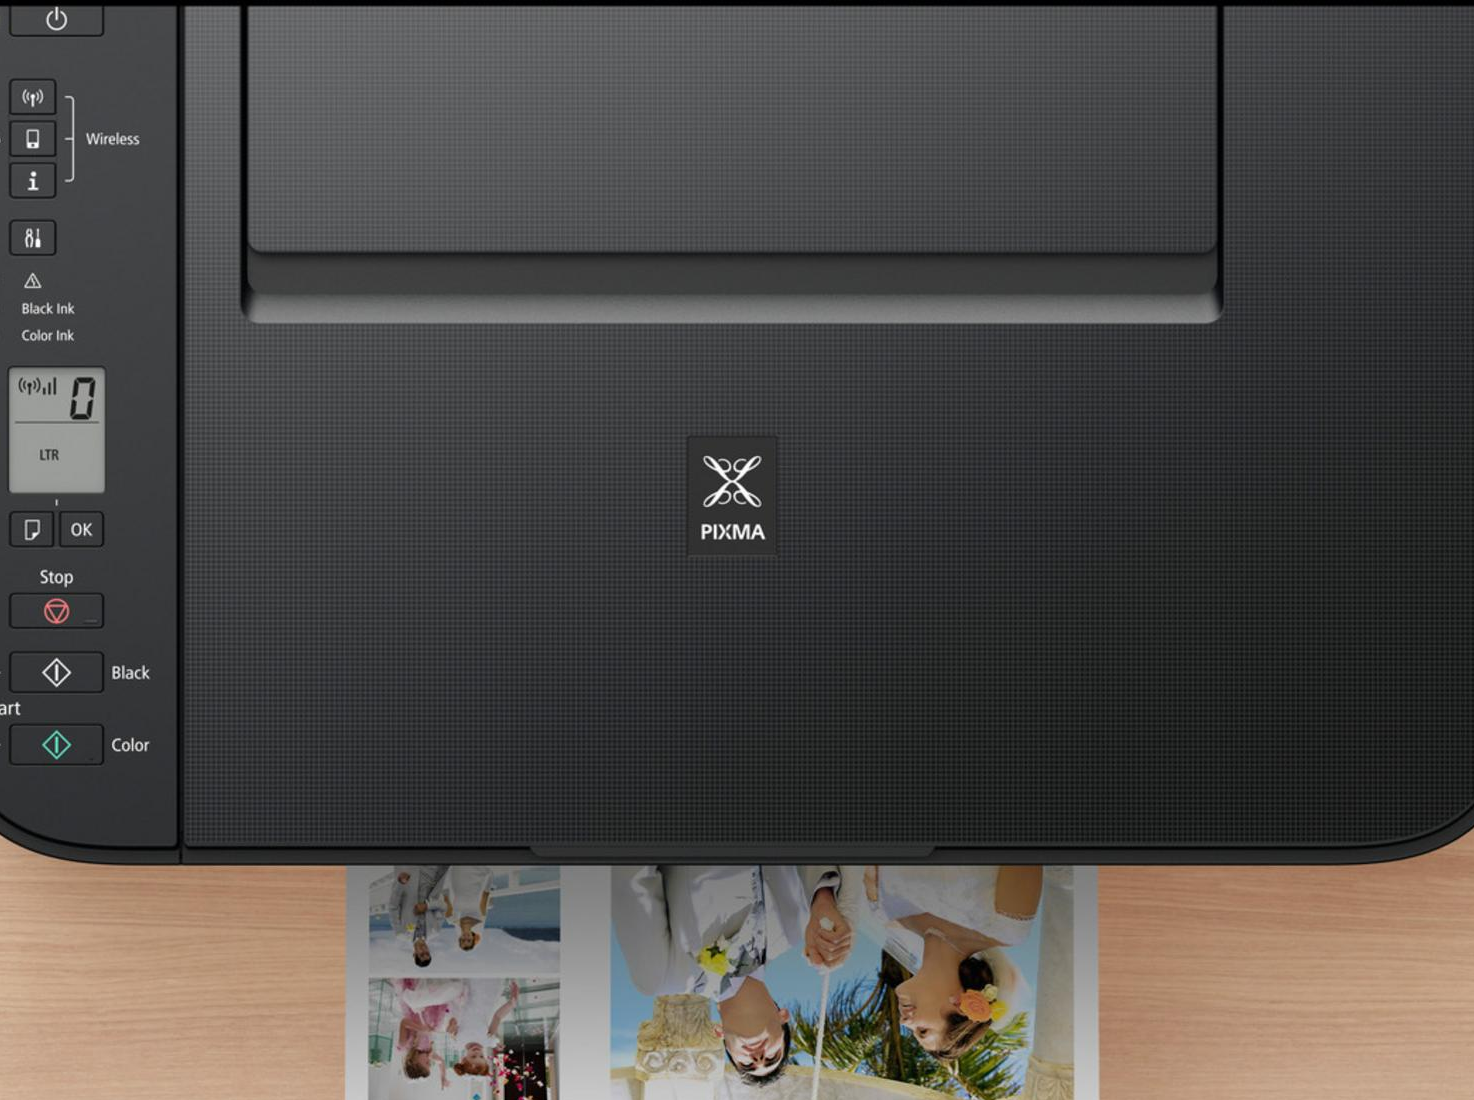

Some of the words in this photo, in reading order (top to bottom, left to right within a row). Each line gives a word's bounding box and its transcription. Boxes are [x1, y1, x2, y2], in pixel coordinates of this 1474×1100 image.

[85, 131, 140, 146] Wireless
[21, 301, 54, 315] Black
[57, 301, 75, 315] Ink
[21, 328, 54, 342] Color
[57, 328, 75, 342] Ink
[39, 448, 60, 461] LTR
[70, 522, 93, 538] OK
[700, 523, 766, 540] PIXMA
[39, 569, 74, 588] Stop
[111, 664, 151, 681] Black
[111, 736, 150, 753] Color
